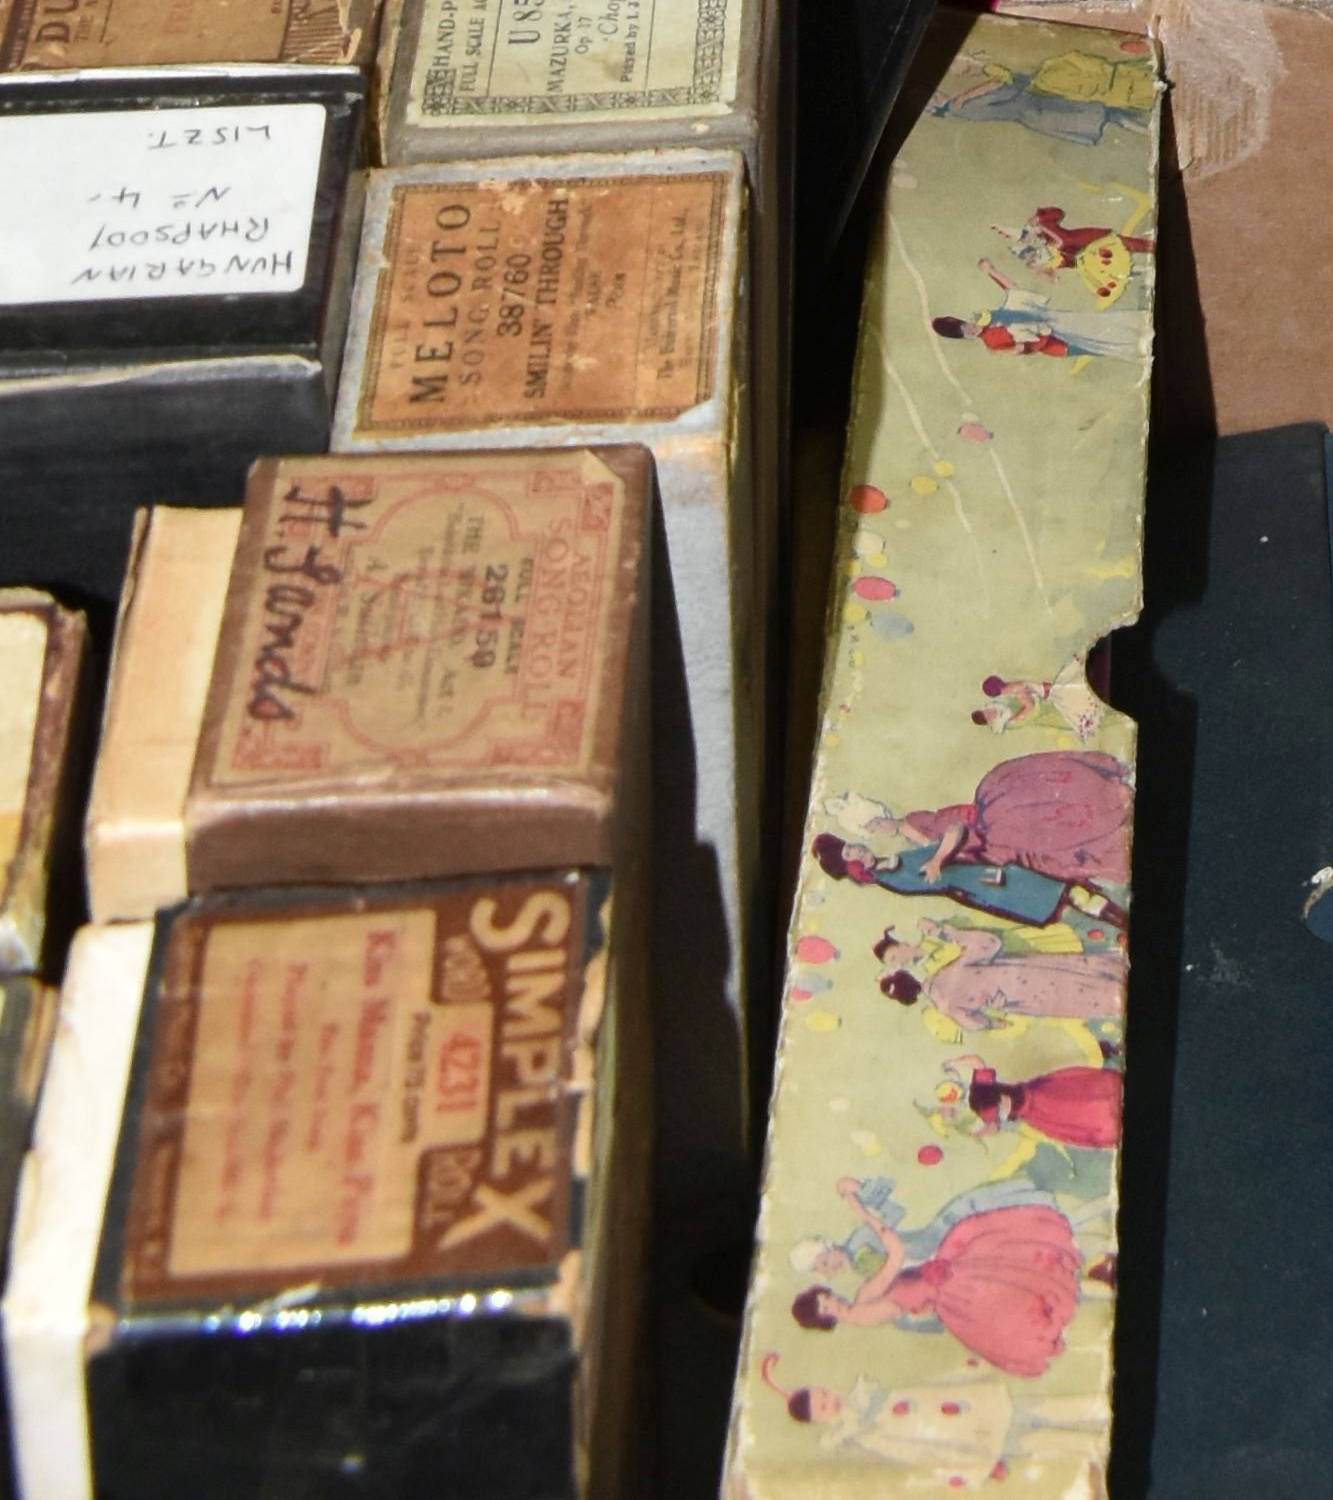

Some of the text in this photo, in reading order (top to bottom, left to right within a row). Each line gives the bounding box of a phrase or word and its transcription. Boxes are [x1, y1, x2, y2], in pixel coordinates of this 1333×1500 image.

[464, 17, 485, 56] SCALE
[507, 28, 542, 46] U
[547, 4, 576, 93] MAZURKA,
[619, 41, 638, 84] Played
[625, 23, 640, 38] by
[459, 61, 480, 93] FULL
[69, 251, 293, 286] HUNGARIAN
[88, 217, 269, 252] RHAPSODY
[534, 198, 569, 309] THROUGH
[408, 203, 471, 404] MELOTO
[497, 252, 532, 338] 38760
[524, 318, 553, 400] SMILIN'
[513, 558, 533, 604] FULL
[521, 517, 573, 721] SONG ROLL
[556, 551, 592, 679] AEOLIAN
[436, 891, 572, 1252] SIMPLEX
[437, 1031, 484, 1115] 4231
